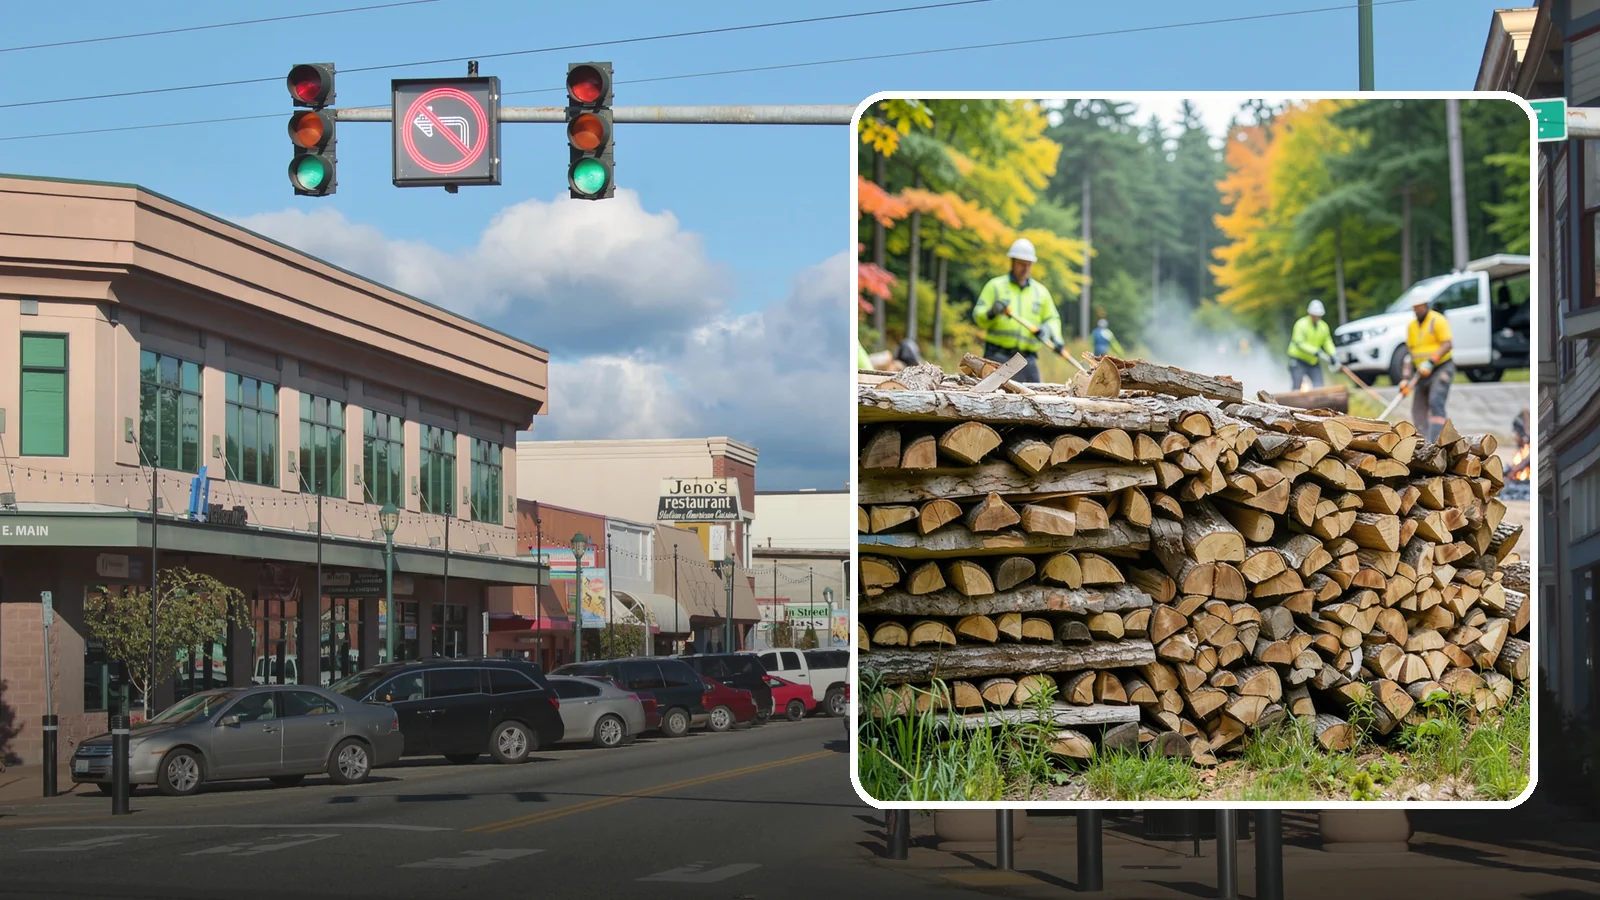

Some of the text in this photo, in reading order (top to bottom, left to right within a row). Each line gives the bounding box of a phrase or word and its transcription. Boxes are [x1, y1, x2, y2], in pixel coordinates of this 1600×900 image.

[669, 480, 727, 494] Jeno's
[665, 496, 731, 508] restaurant
[659, 510, 681, 519] Italian
[686, 510, 715, 519] American
[715, 509, 737, 519] Cuisine
[2, 525, 49, 536] E. MAIN
[797, 607, 828, 617] Street
[791, 619, 823, 628] lass
